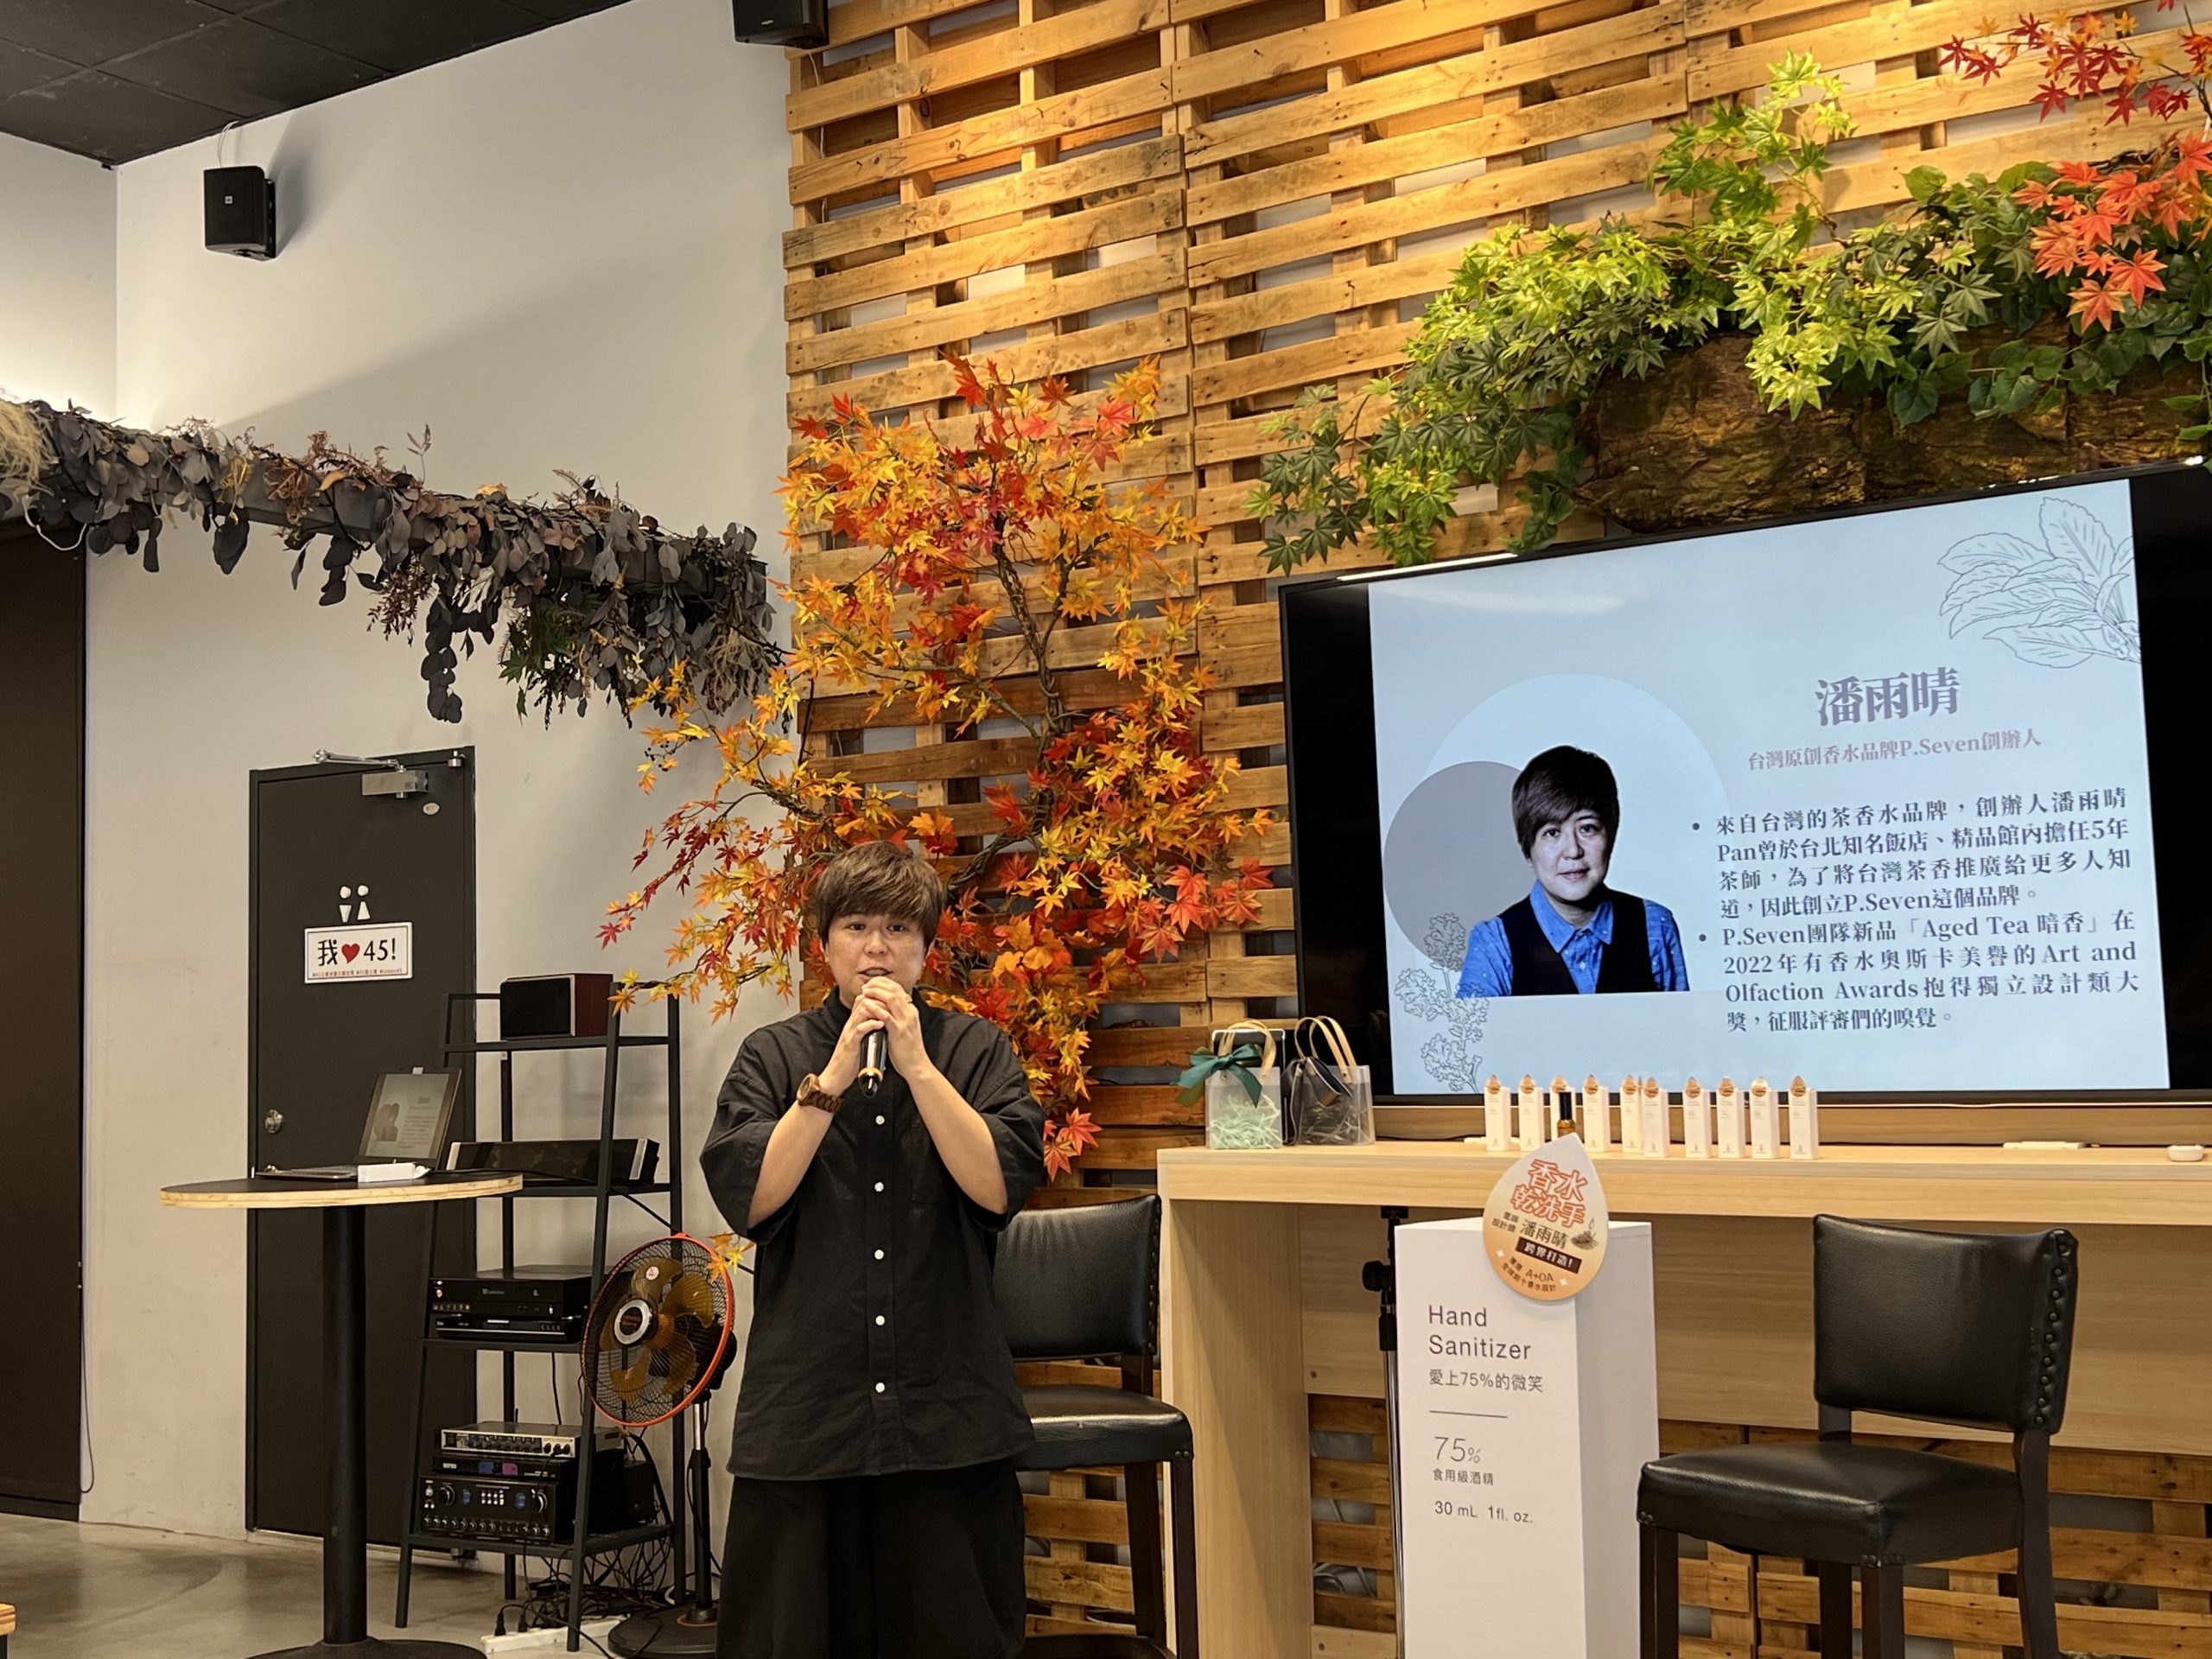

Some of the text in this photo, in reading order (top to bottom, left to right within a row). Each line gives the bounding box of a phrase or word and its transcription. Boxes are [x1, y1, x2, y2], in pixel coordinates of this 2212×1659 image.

[1815, 666, 1960, 727] 潘雨晴
[1748, 728, 2042, 771] 台灣原創香水品牌P.Seven創辦人
[1986, 916, 2030, 935] Tea
[317, 938, 396, 967] 我 45!
[2091, 941, 2137, 962] and
[1725, 982, 1824, 1002] Olfaction
[1528, 1159, 1588, 1202] 香水
[1510, 1184, 1586, 1228] 乾洗手
[1519, 1218, 1569, 1249] 潘雨晴
[1428, 1304, 1487, 1327] Hand
[1428, 1334, 1531, 1360] Sanitizer
[1429, 1369, 1543, 1393] 愛上75%的微笑
[1434, 1436, 1481, 1464] 75%
[1433, 1468, 1494, 1486] 食用級酒精
[1434, 1500, 1452, 1515] 30
[1458, 1505, 1478, 1518] mL
[1513, 1512, 1534, 1524] oz.
